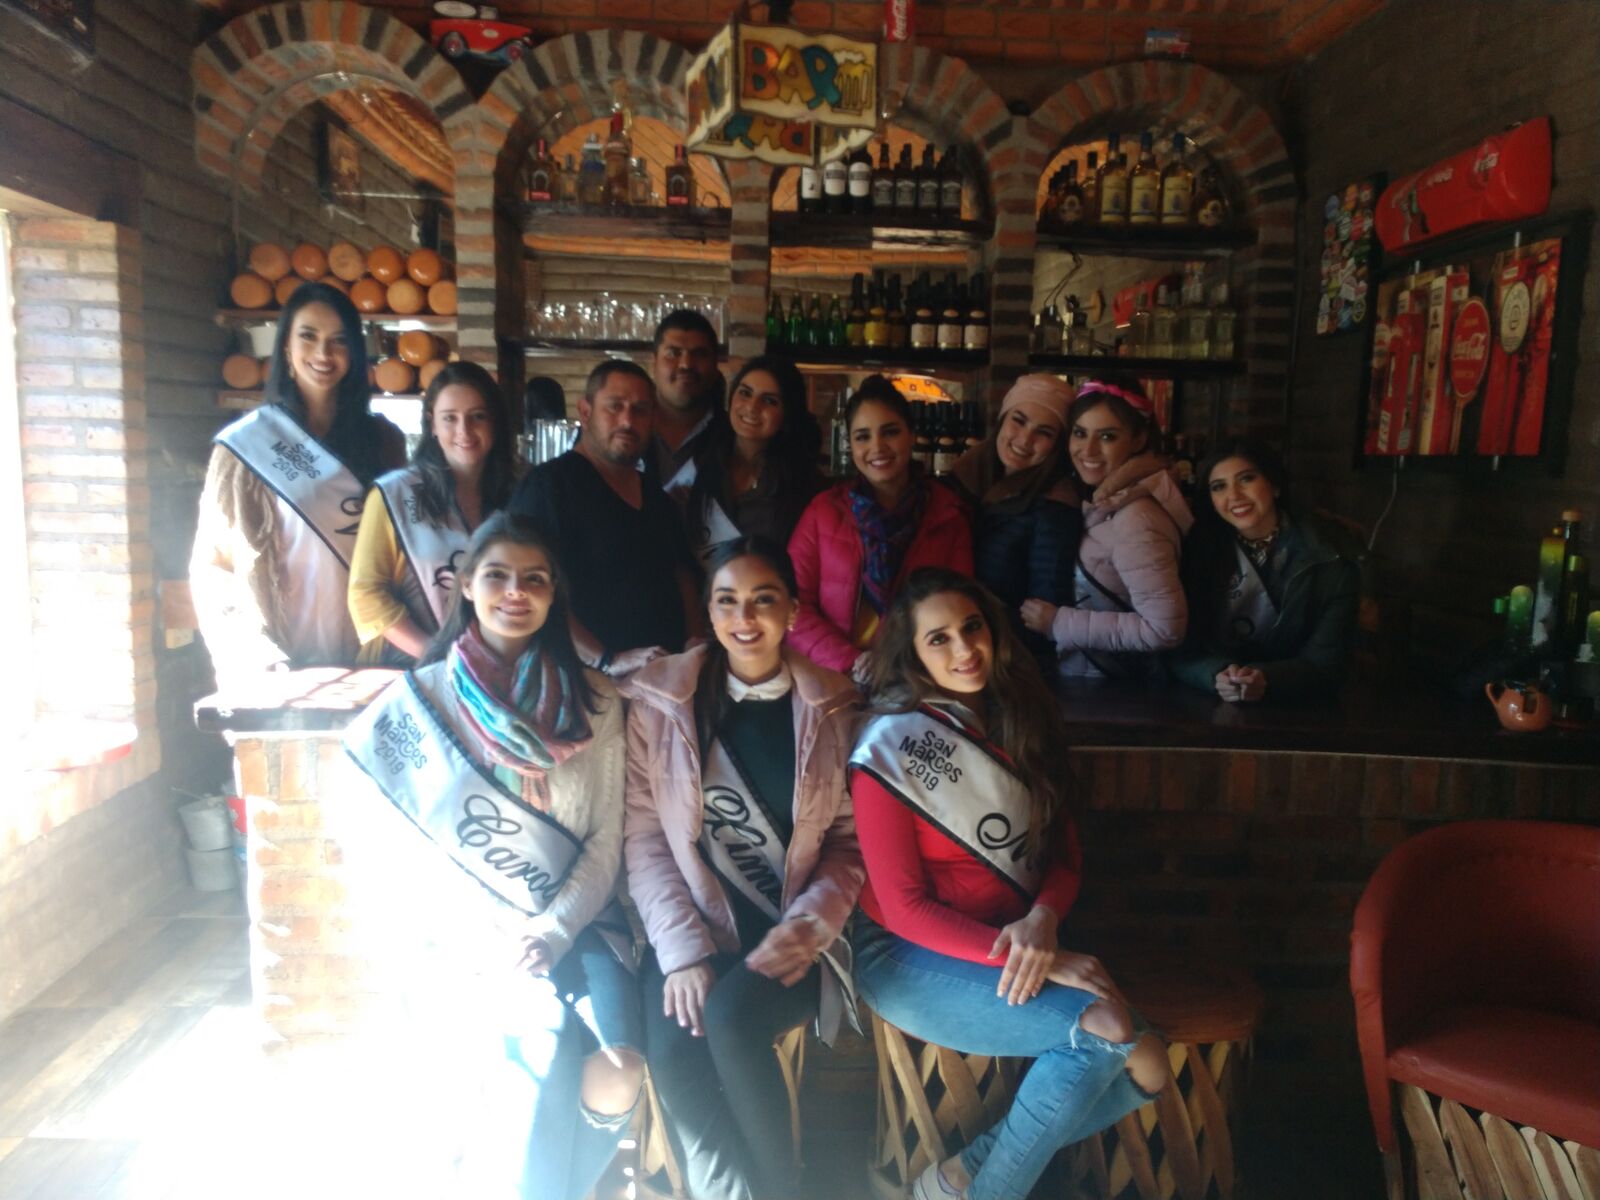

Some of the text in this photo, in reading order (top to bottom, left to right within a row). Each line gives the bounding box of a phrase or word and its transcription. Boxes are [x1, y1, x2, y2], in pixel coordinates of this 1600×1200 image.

[742, 39, 841, 110] BAR
[272, 457, 299, 482] 2019
[374, 740, 406, 776] 2019
[905, 759, 939, 791] 2019
